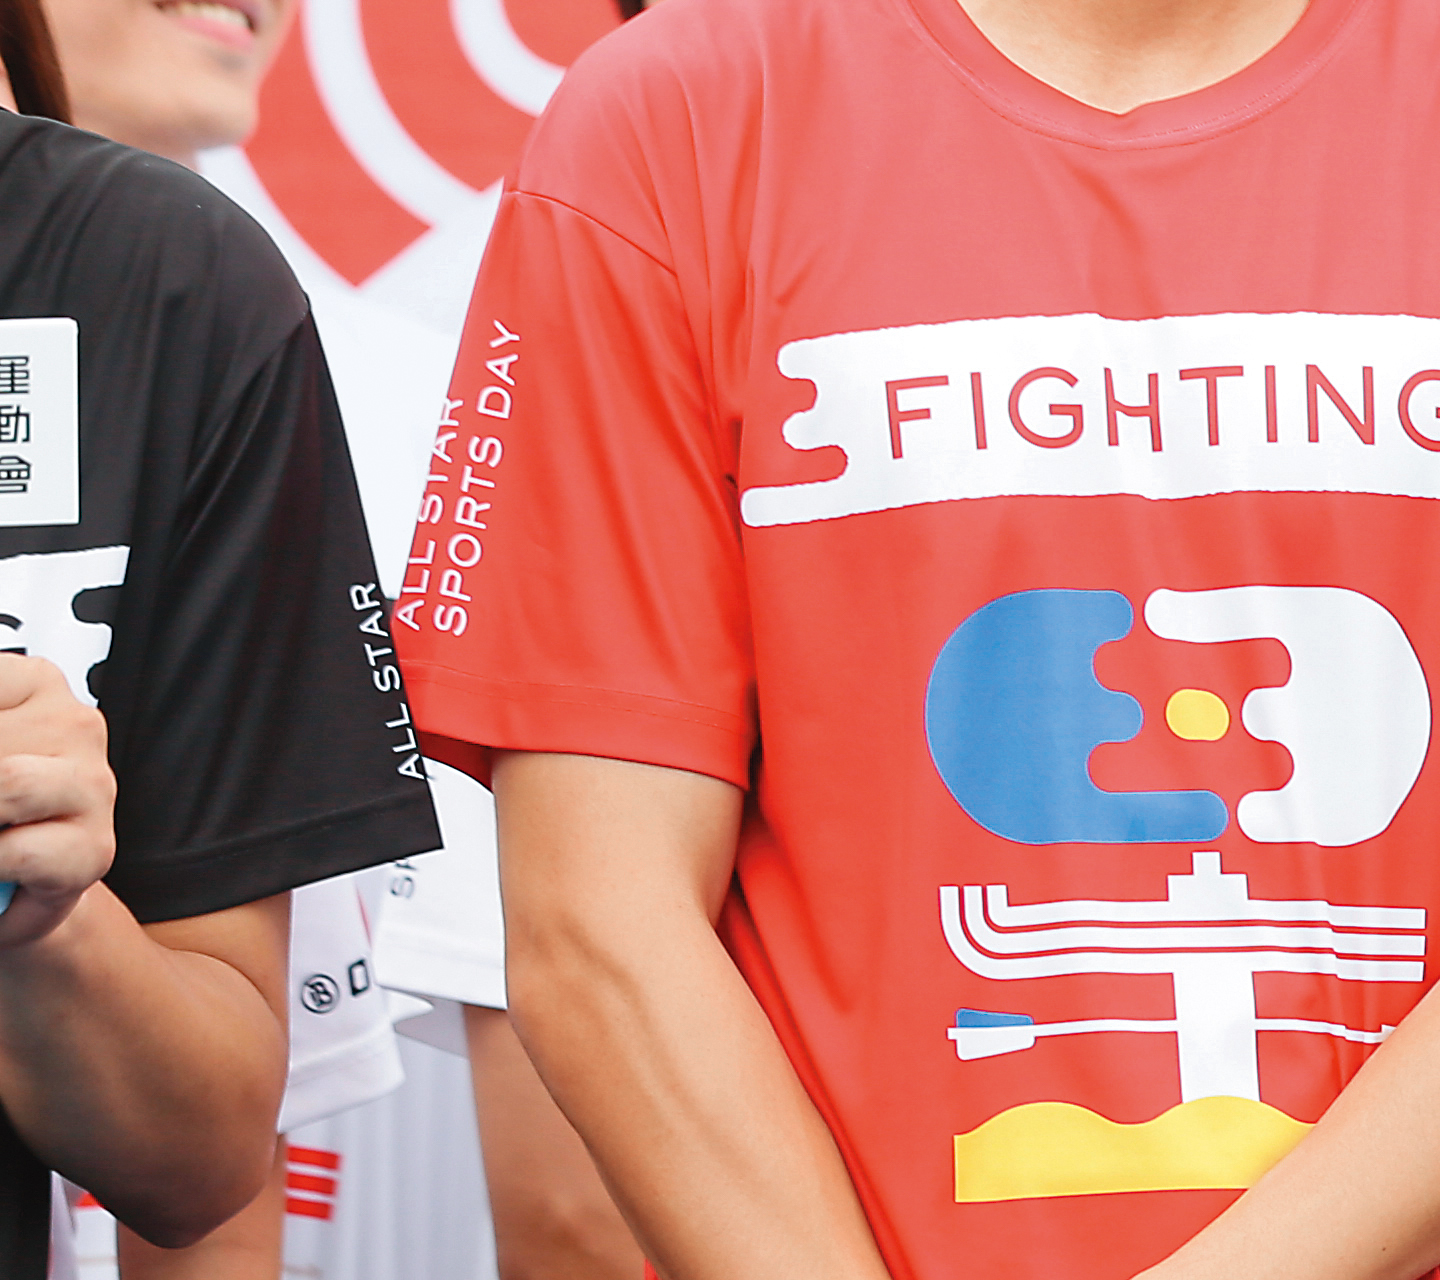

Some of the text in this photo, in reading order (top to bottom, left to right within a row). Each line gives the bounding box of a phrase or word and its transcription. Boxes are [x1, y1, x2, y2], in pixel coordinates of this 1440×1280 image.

[396, 396, 465, 631] ALL STAR
[432, 318, 521, 637] SPORTS DAY
[348, 580, 427, 781] ALL STAR
